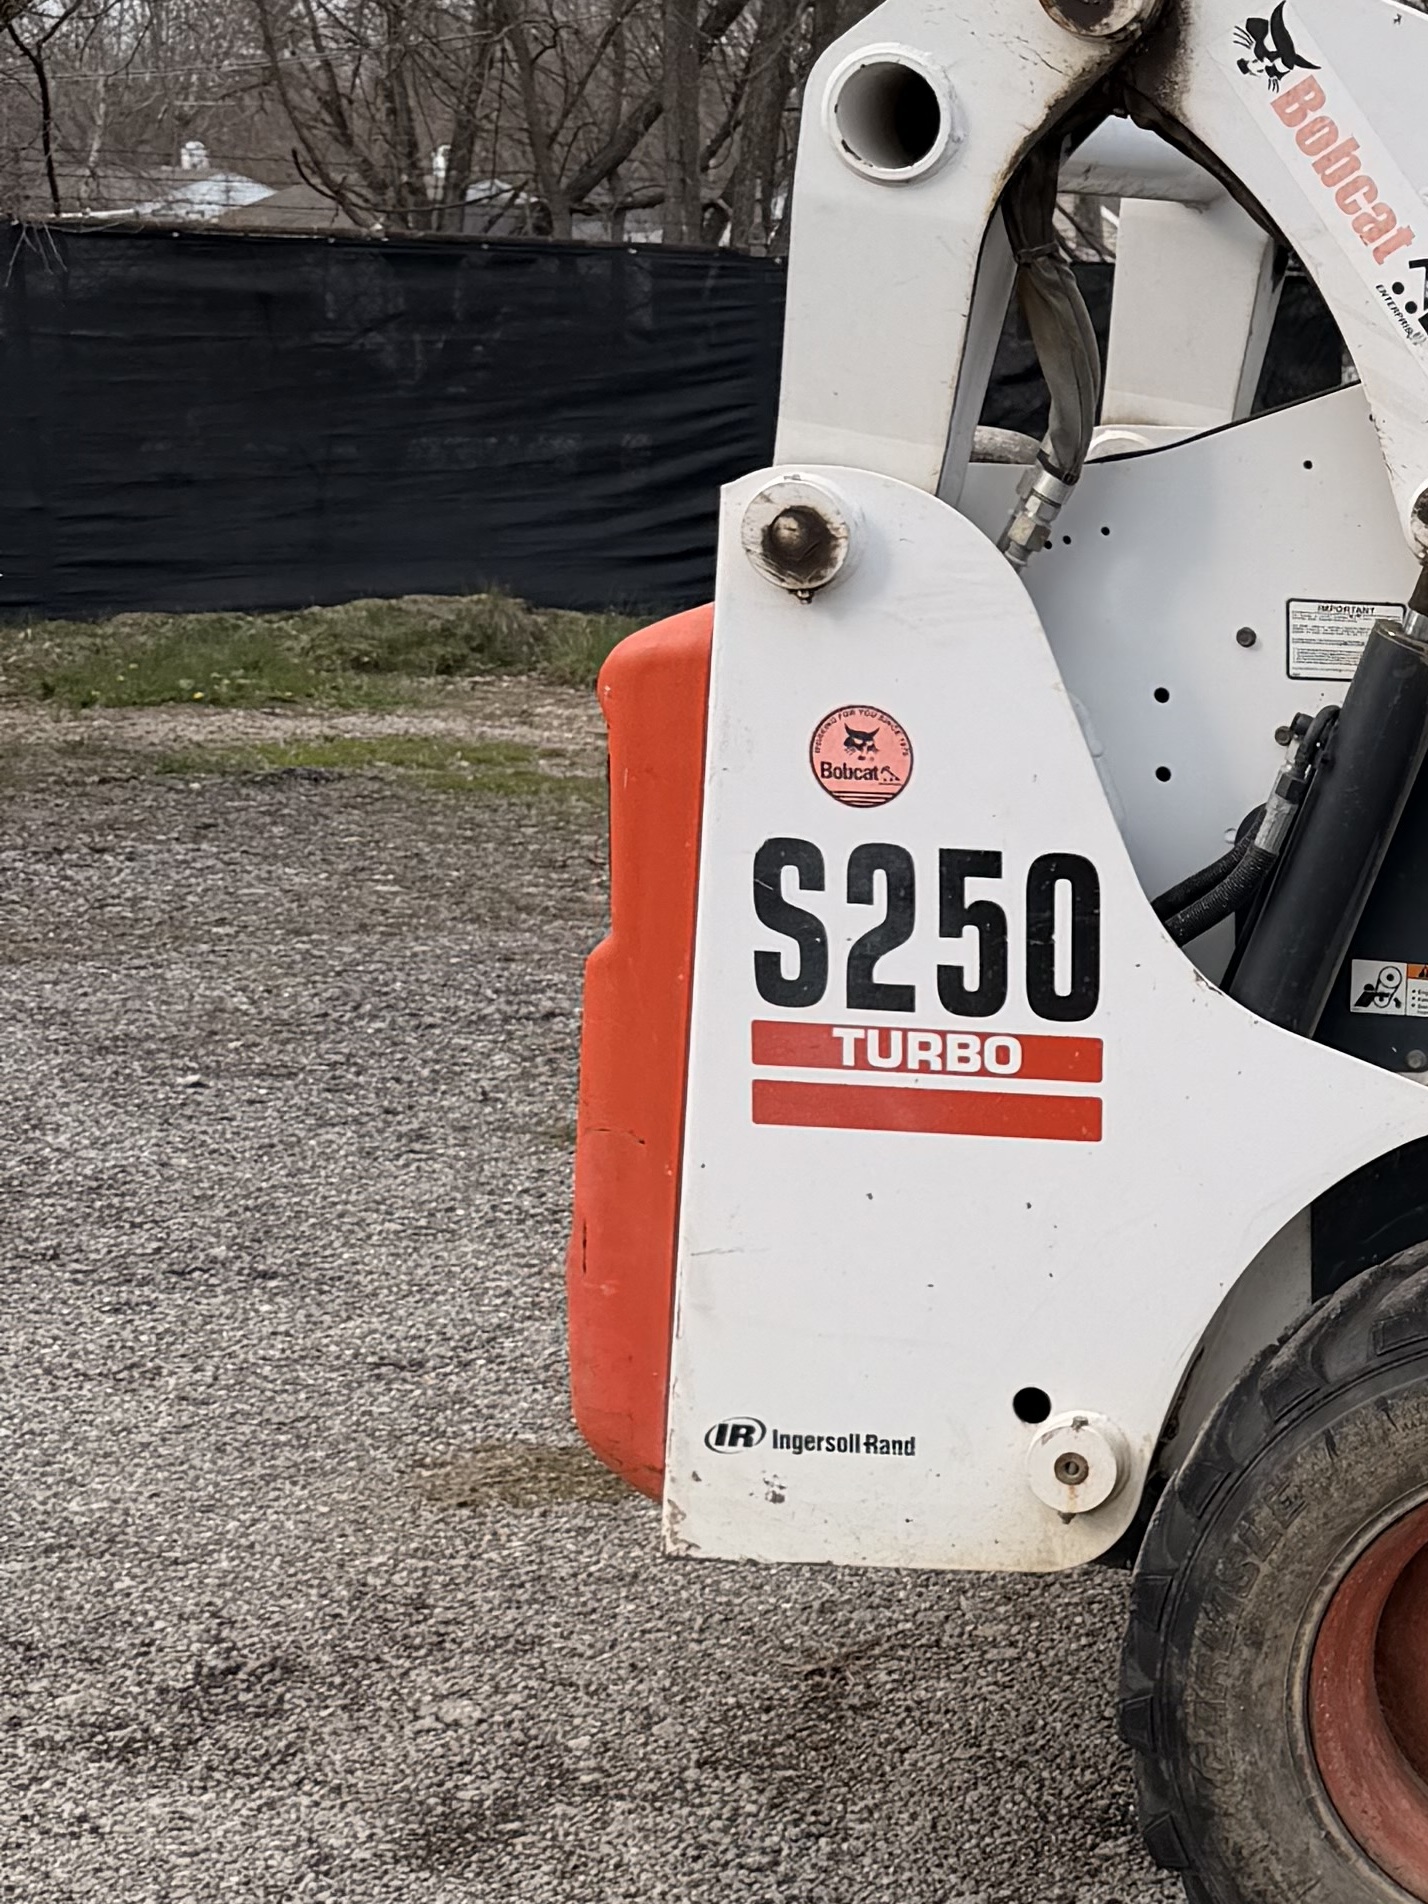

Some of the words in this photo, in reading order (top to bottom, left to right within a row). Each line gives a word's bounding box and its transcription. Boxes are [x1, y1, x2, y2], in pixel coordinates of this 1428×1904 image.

[1270, 74, 1415, 266] Bobcat
[1317, 604, 1375, 614] IMPORTANT
[820, 760, 879, 781] Bobcat
[753, 837, 1100, 1022] S250
[832, 1027, 1023, 1075] TURBO
[714, 1423, 757, 1448] IR
